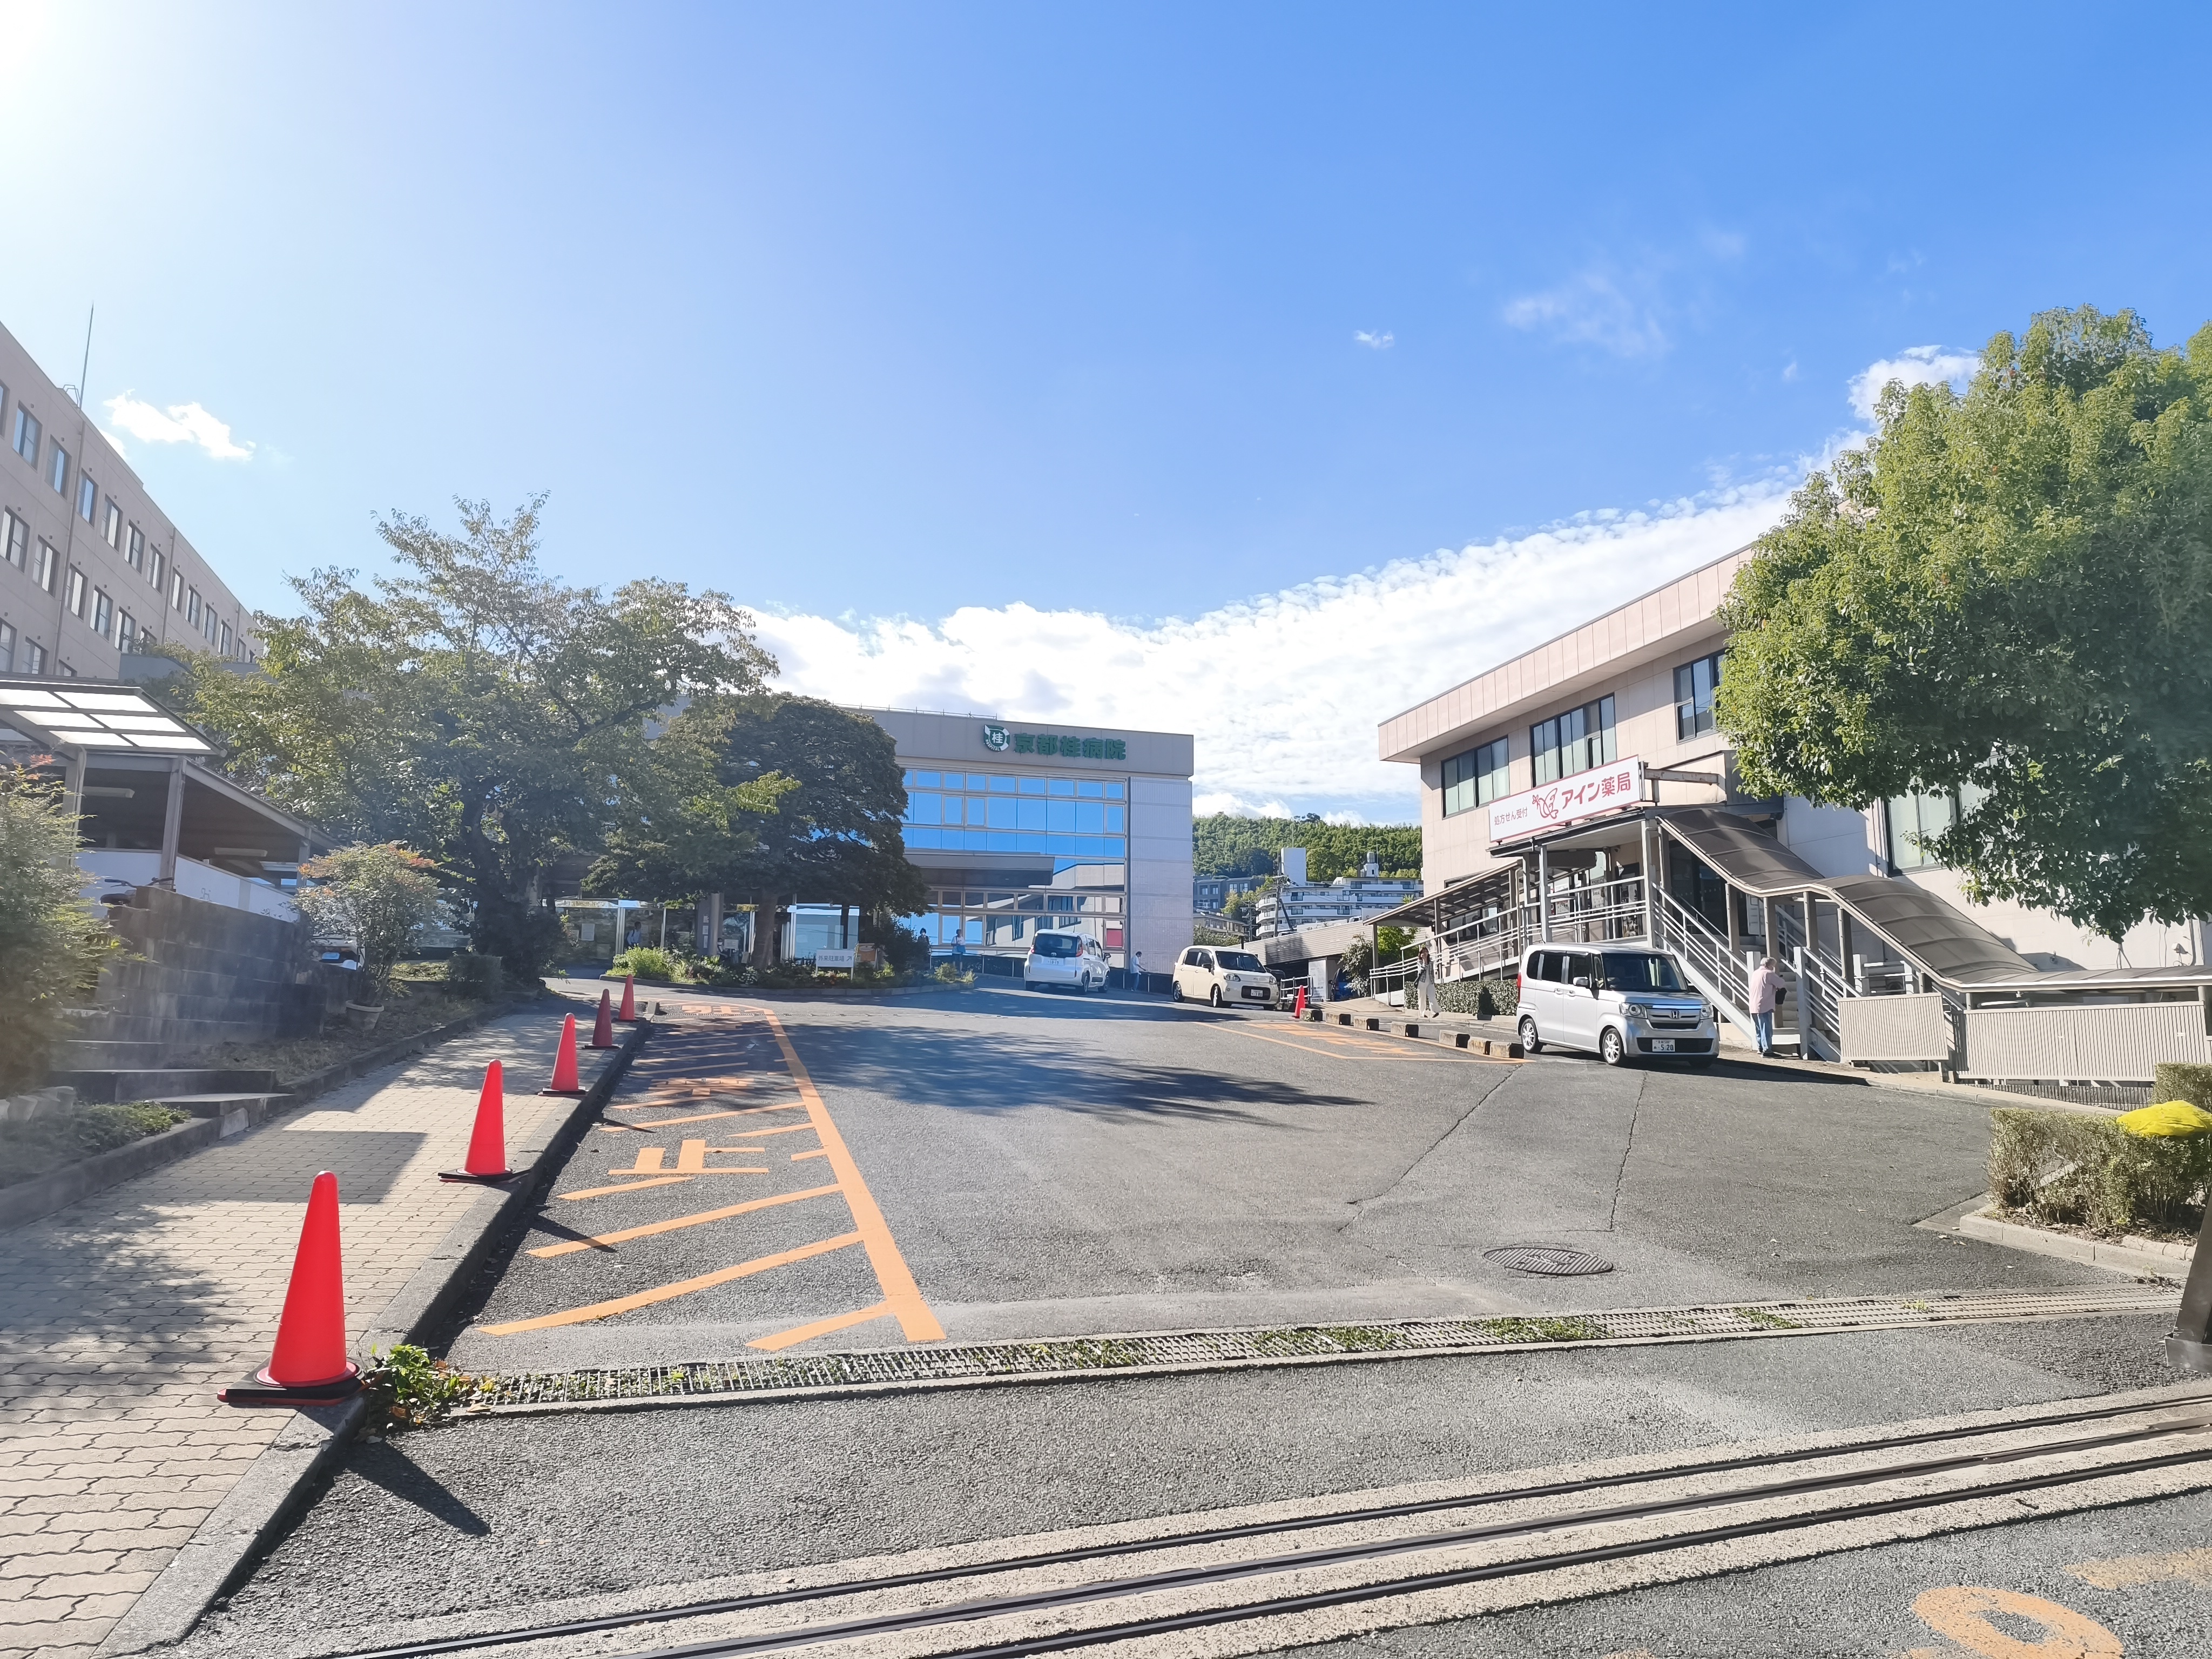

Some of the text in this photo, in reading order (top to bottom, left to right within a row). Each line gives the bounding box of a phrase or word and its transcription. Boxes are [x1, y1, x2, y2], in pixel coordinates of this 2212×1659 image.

[1014, 733, 1126, 760] 京都桂病院
[1562, 772, 1631, 810] アイン薬局
[1494, 807, 1528, 825] 処方せん受付
